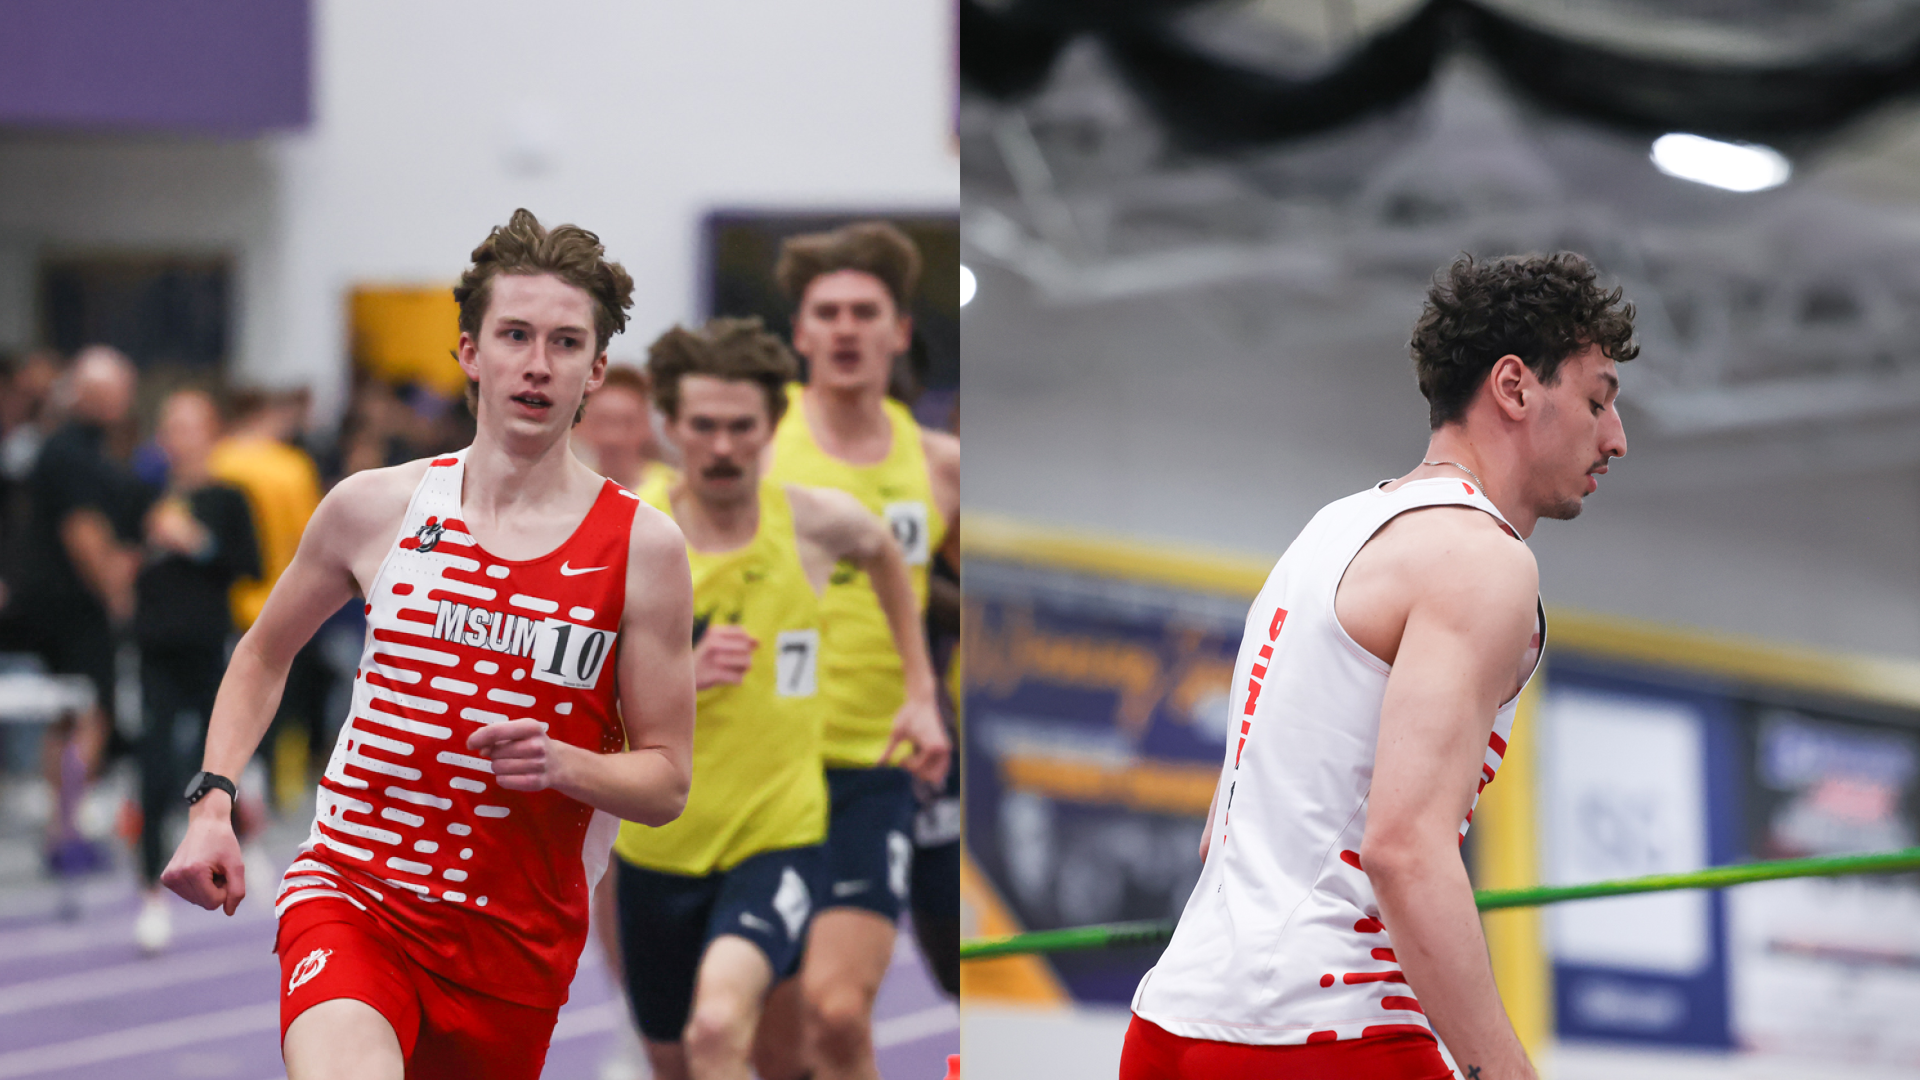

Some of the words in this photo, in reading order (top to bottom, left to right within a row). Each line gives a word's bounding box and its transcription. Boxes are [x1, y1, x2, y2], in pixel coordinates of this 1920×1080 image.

[432, 599, 546, 660] MSUM
[541, 624, 606, 681] 10
[781, 641, 808, 691] 7
